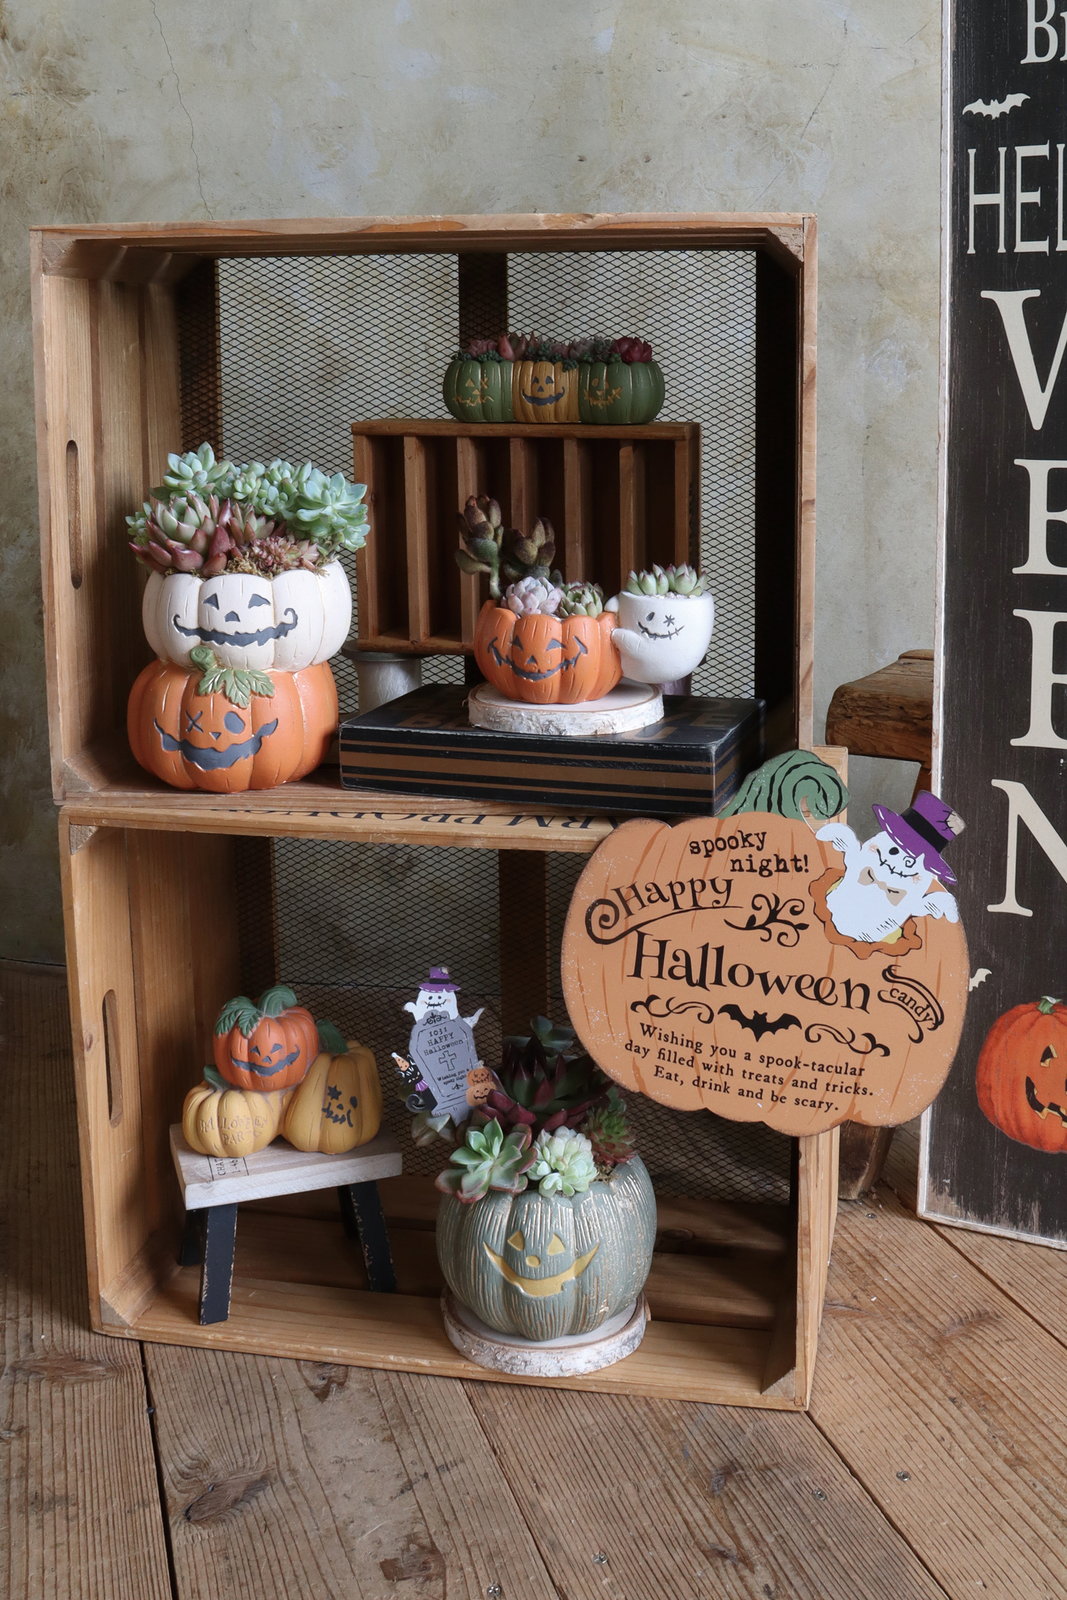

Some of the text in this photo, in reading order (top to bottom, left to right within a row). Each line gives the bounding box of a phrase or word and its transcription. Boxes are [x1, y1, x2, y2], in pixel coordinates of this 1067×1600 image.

[689, 830, 767, 857] spooky
[730, 854, 809, 877] night!
[611, 876, 734, 918] Happy
[627, 929, 870, 1015] Halloween
[889, 987, 933, 1024] candy
[423, 1039, 464, 1057] Halloween
[427, 1032, 455, 1047] HAPPY
[639, 1022, 866, 1078] Wishing you a spook-tacular
[624, 1040, 874, 1097] day filled with treats and tricks.
[653, 1065, 840, 1113] Eat, drink and be scary.
